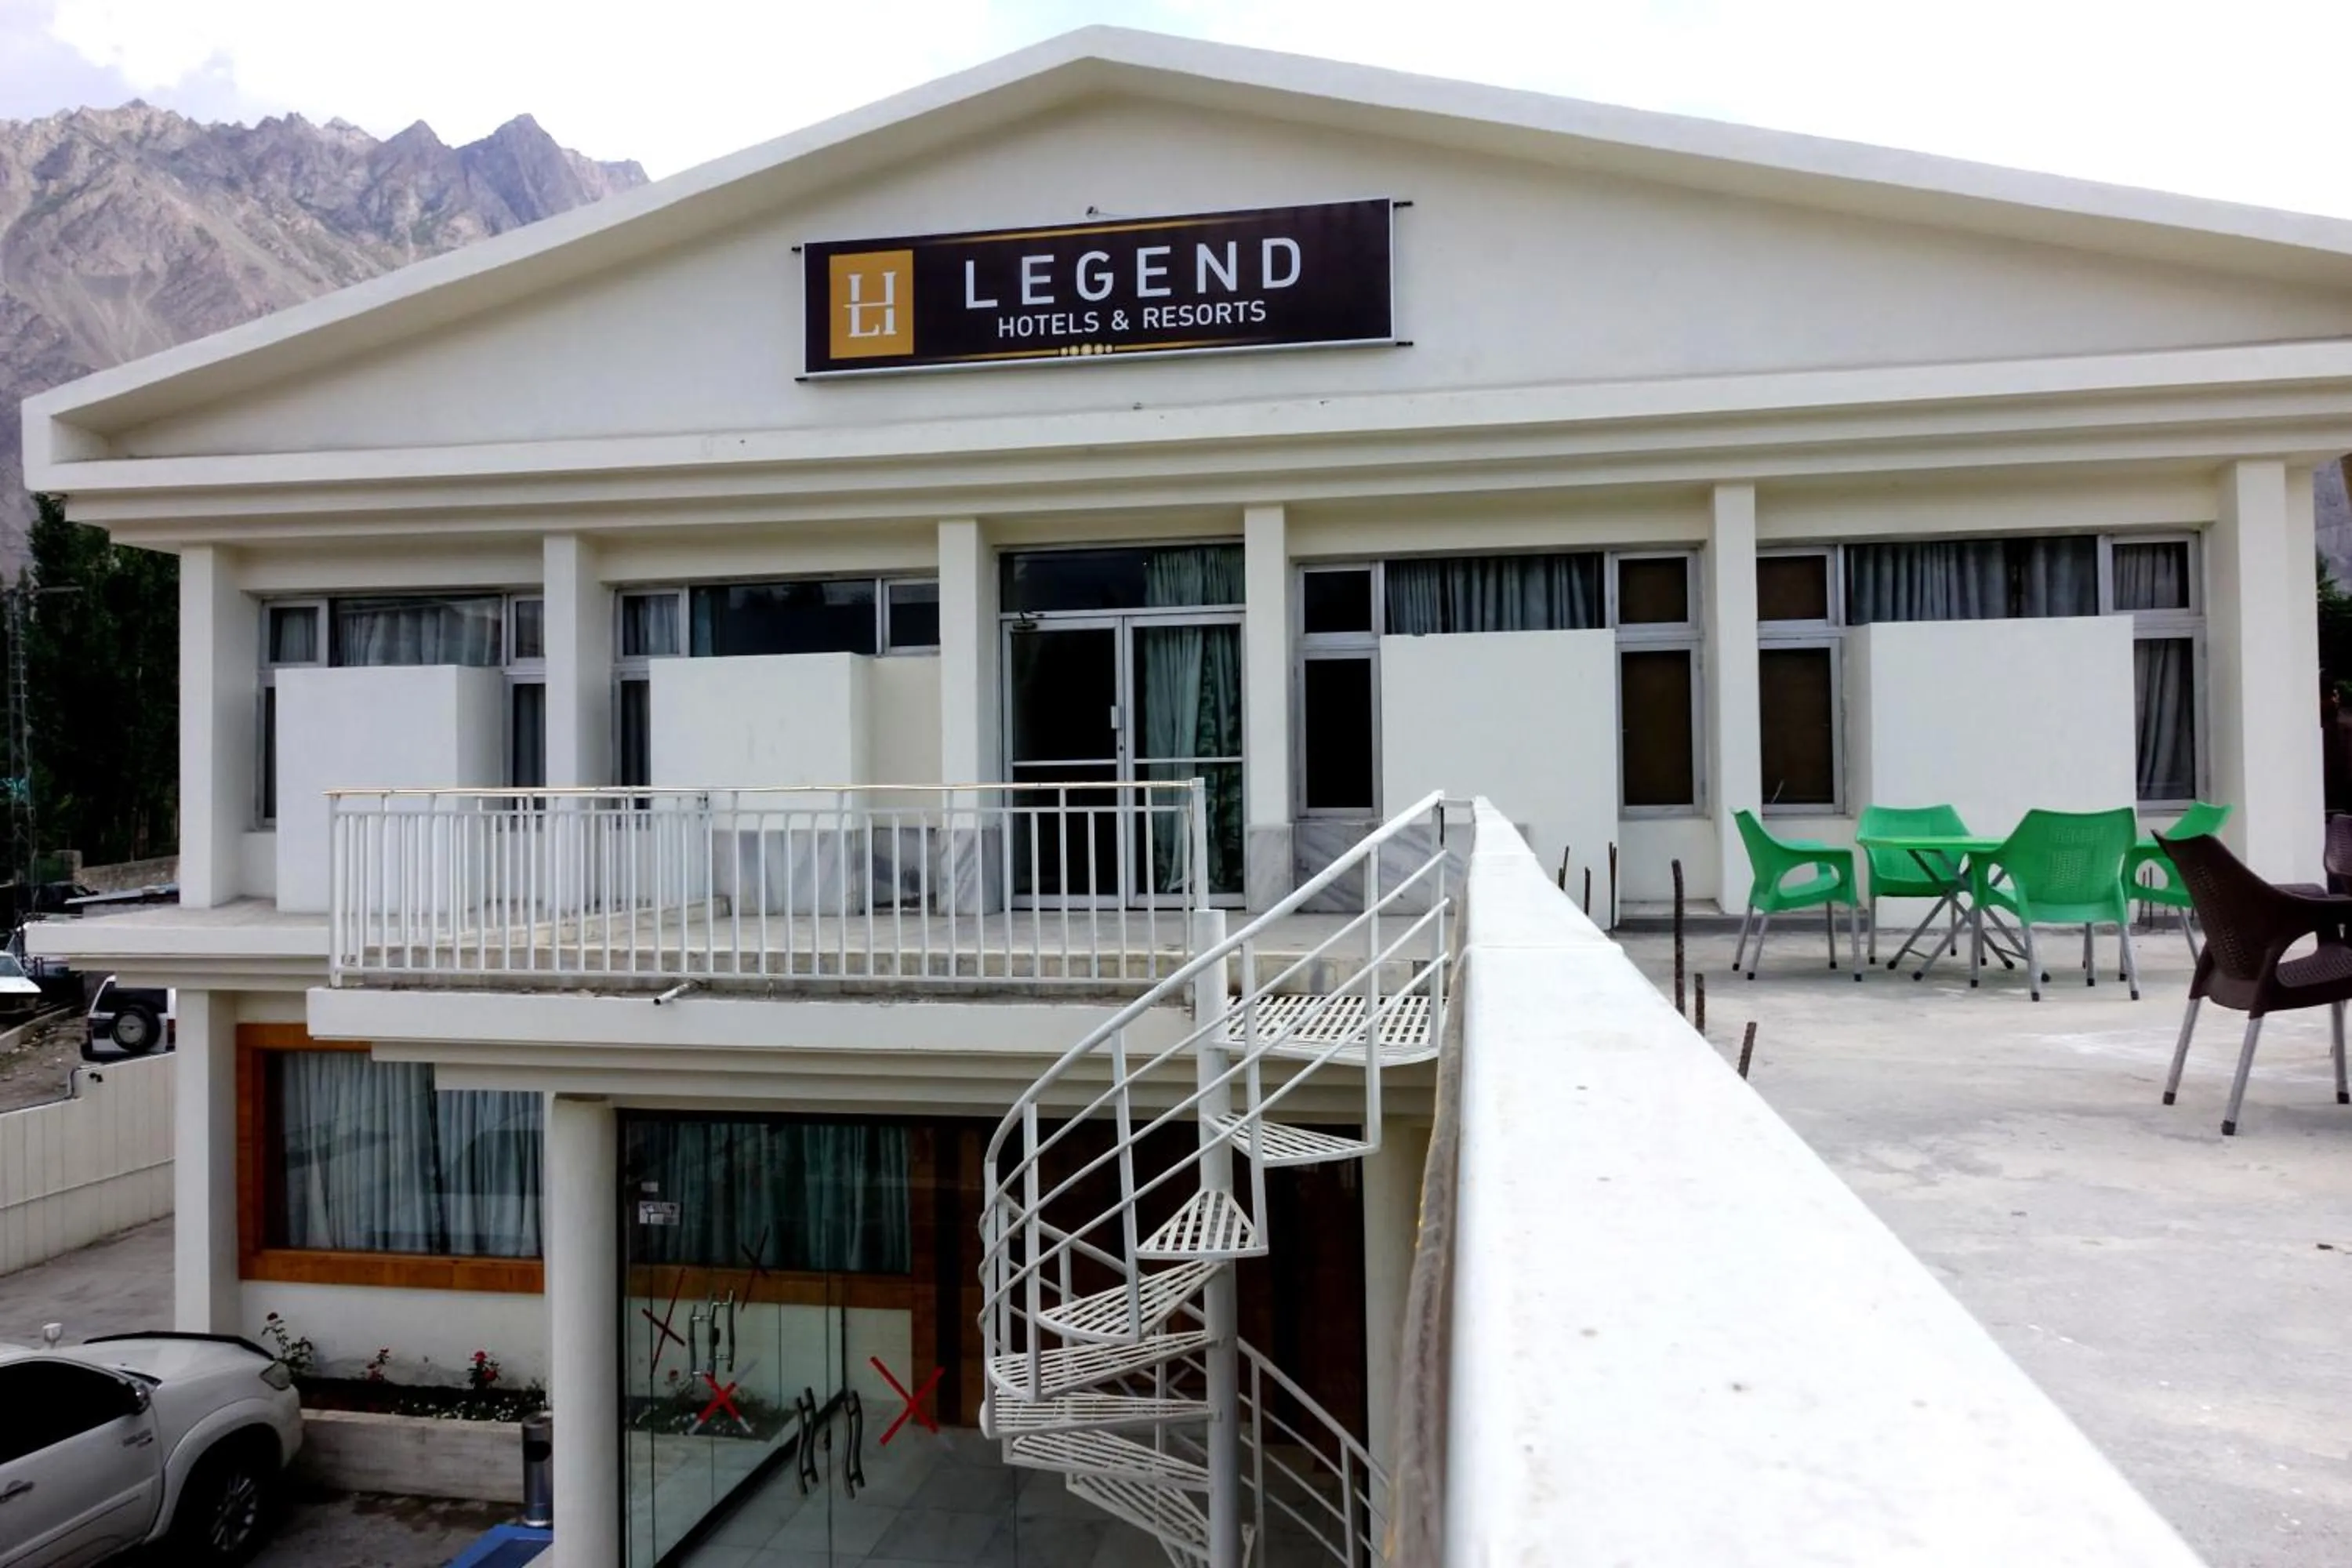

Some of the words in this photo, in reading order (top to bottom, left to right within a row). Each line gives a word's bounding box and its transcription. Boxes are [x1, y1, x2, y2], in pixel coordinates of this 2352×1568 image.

[965, 238, 1301, 309] LEGEND
[998, 311, 1099, 338] HOTELS
[1111, 310, 1130, 331] &
[1143, 300, 1266, 328] RESORTS
